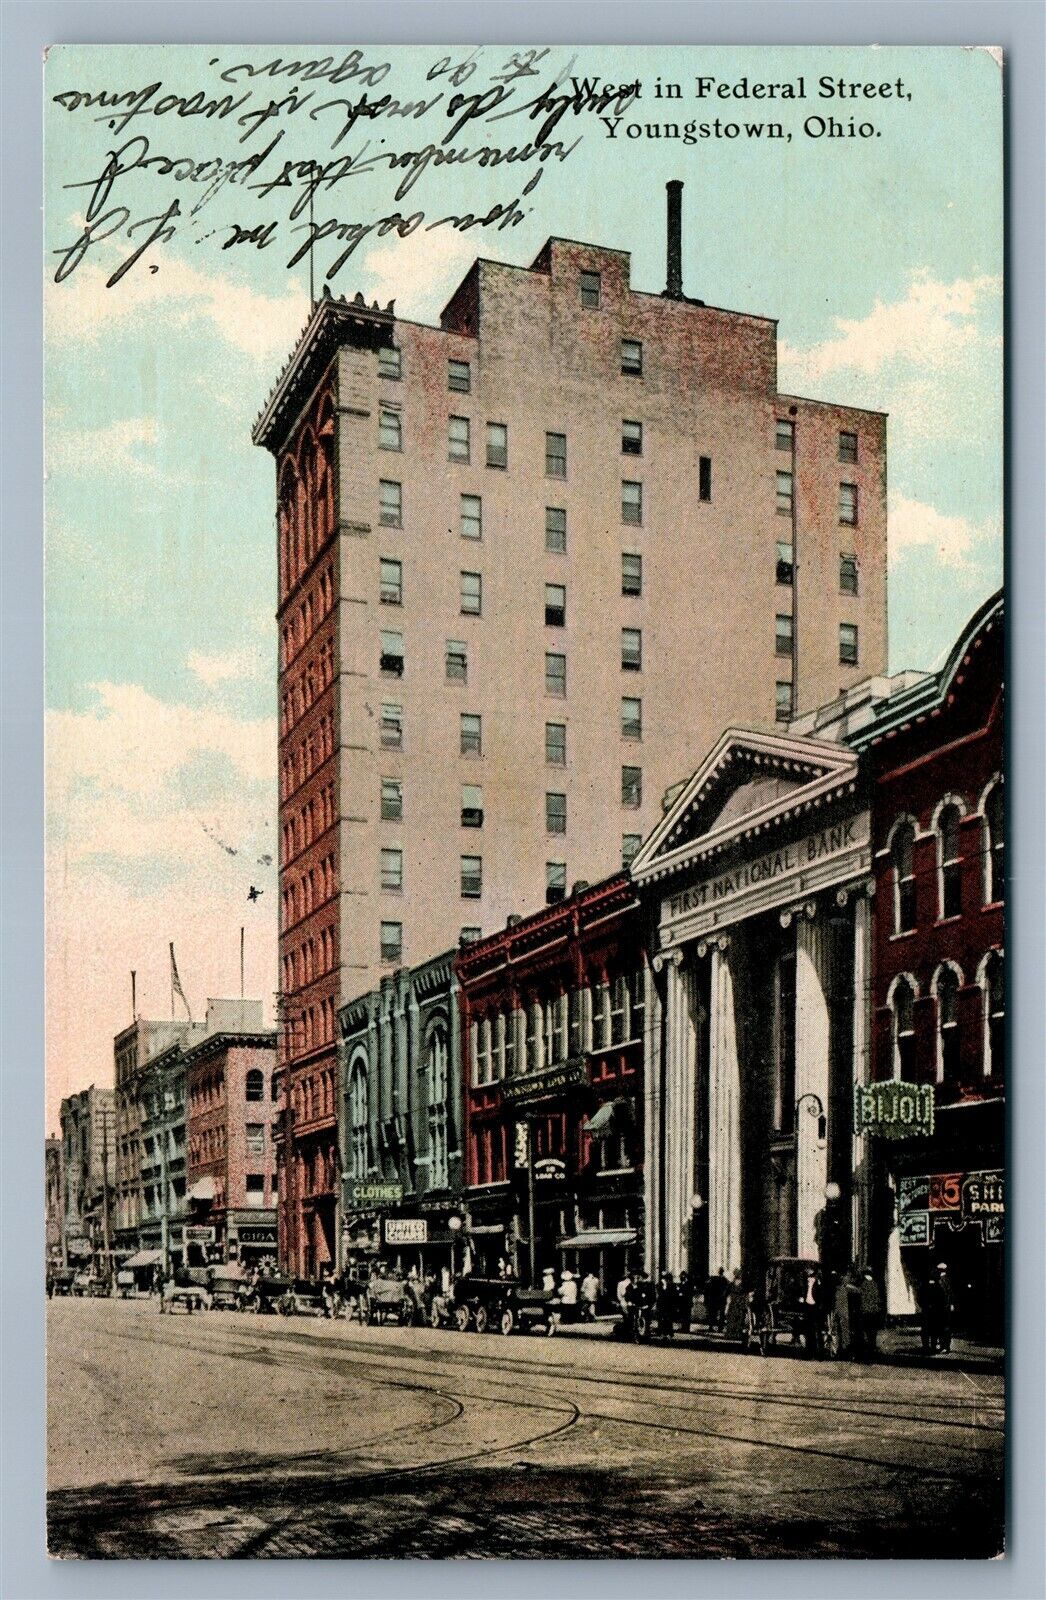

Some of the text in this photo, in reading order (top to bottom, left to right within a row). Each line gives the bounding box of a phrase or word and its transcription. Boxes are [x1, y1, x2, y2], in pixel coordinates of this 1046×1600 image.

[570, 76, 913, 101] West in Federal Street,
[600, 115, 883, 145] Youngstown, Ohio.
[248, 140, 374, 221] that
[671, 824, 855, 917] FIRST NATIONAL BANK
[861, 1093, 931, 1124] BIJOU
[352, 1186, 403, 1199] CLOTHES
